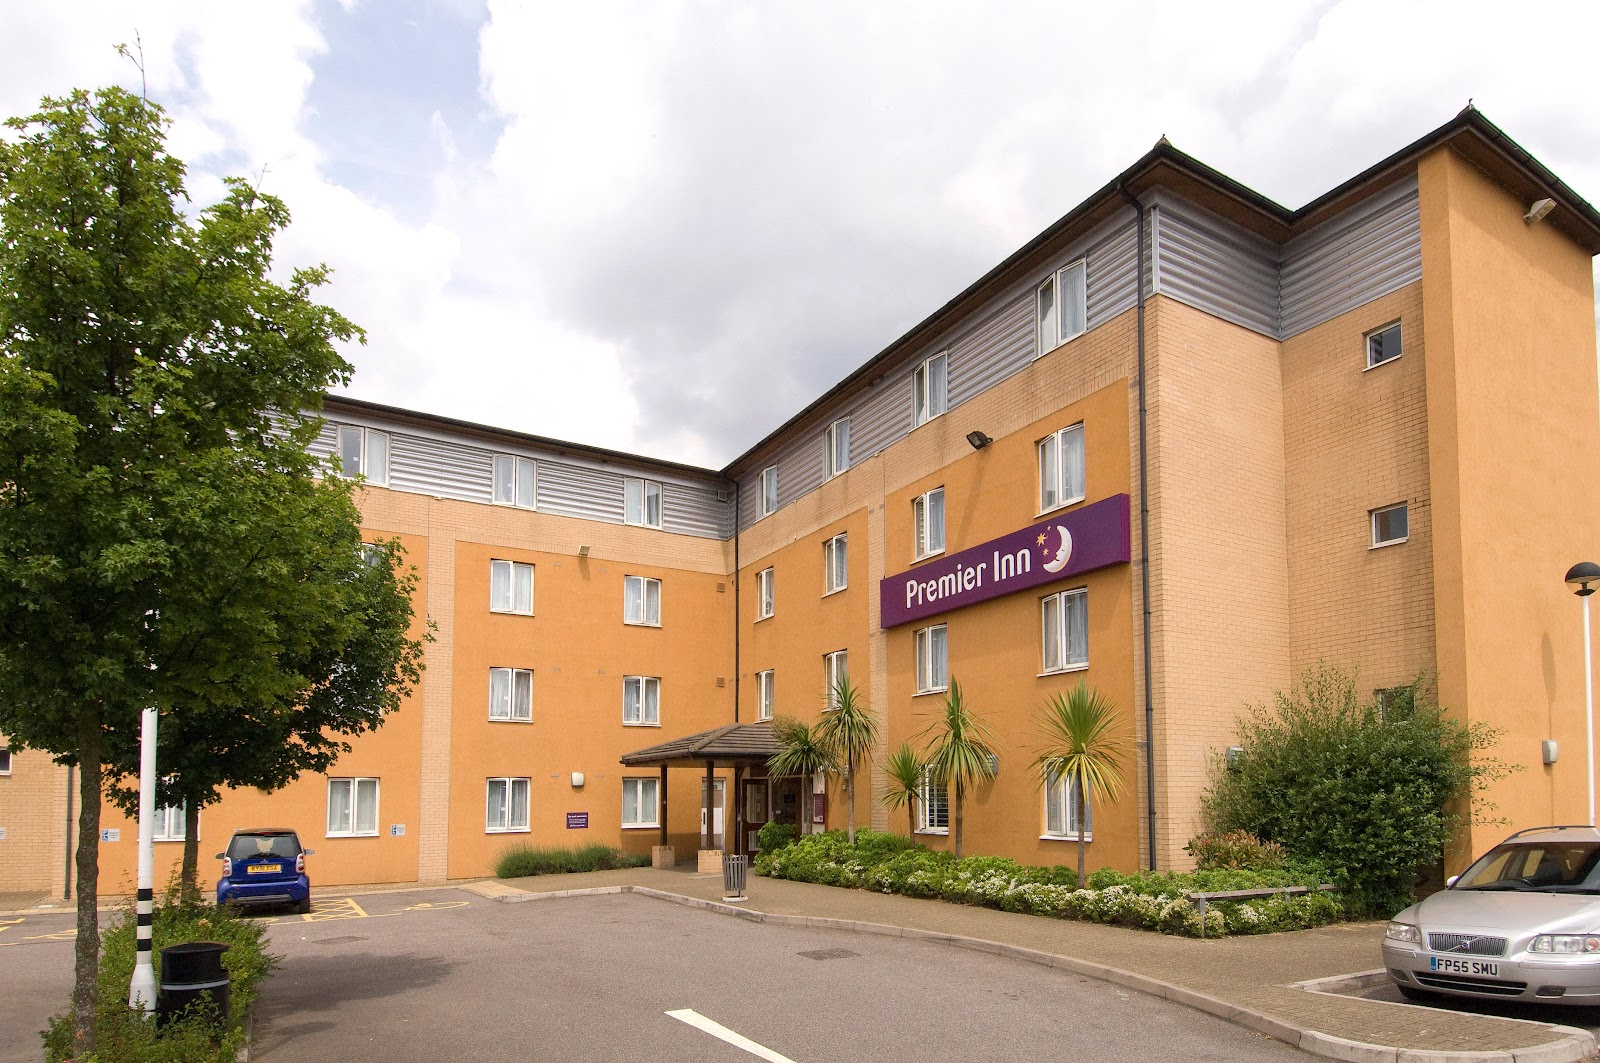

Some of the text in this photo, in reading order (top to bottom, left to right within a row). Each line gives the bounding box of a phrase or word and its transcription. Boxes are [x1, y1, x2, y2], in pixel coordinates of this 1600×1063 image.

[906, 548, 1031, 608] Premier Inn
[1437, 959, 1498, 976] FP55 SMU
